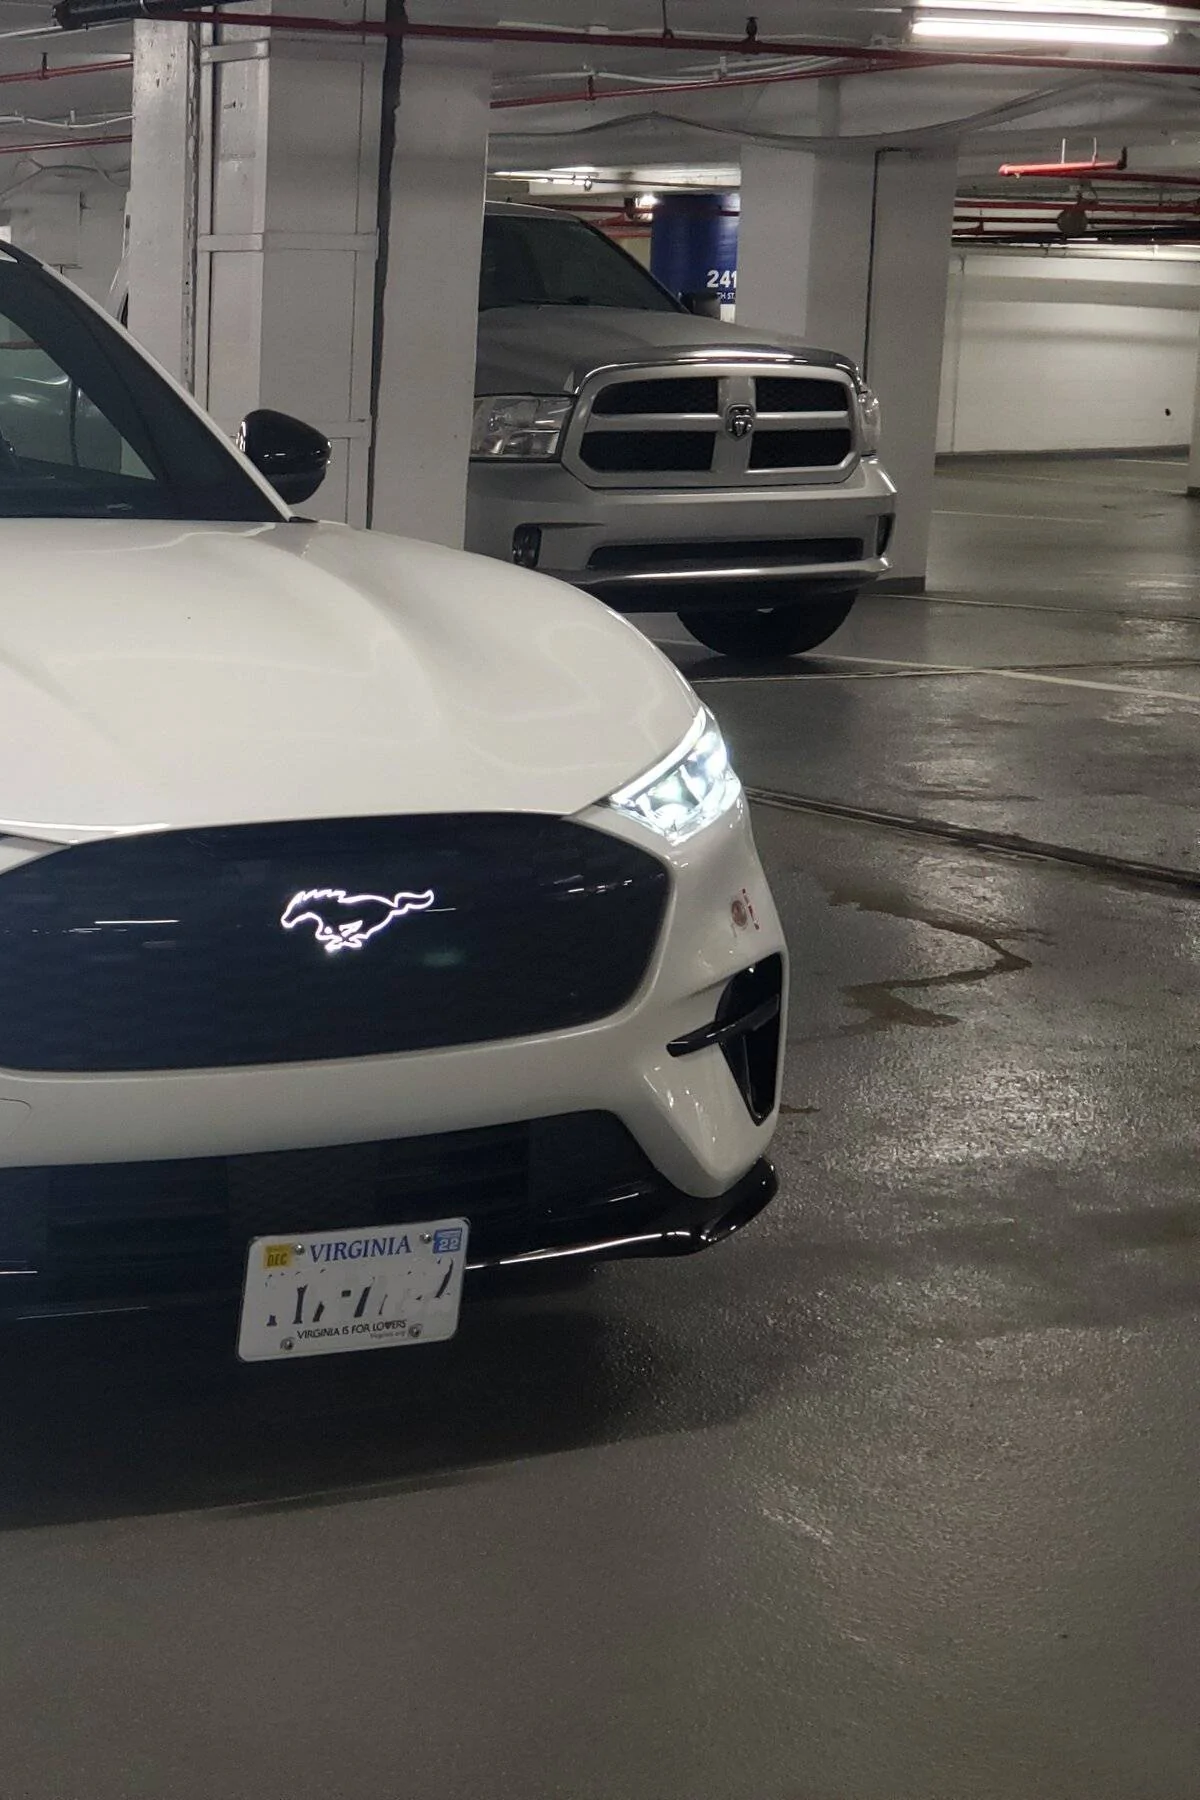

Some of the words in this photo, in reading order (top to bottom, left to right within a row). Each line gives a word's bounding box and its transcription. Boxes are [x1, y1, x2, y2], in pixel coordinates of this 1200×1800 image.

[706, 269, 737, 288] 241
[309, 1235, 412, 1263] VIRGINIA
[438, 1237, 460, 1251] 22
[266, 1252, 288, 1267] DEC
[297, 1327, 340, 1339] VIRGINIA
[341, 1325, 349, 1335] IS
[351, 1322, 370, 1334] FOR
